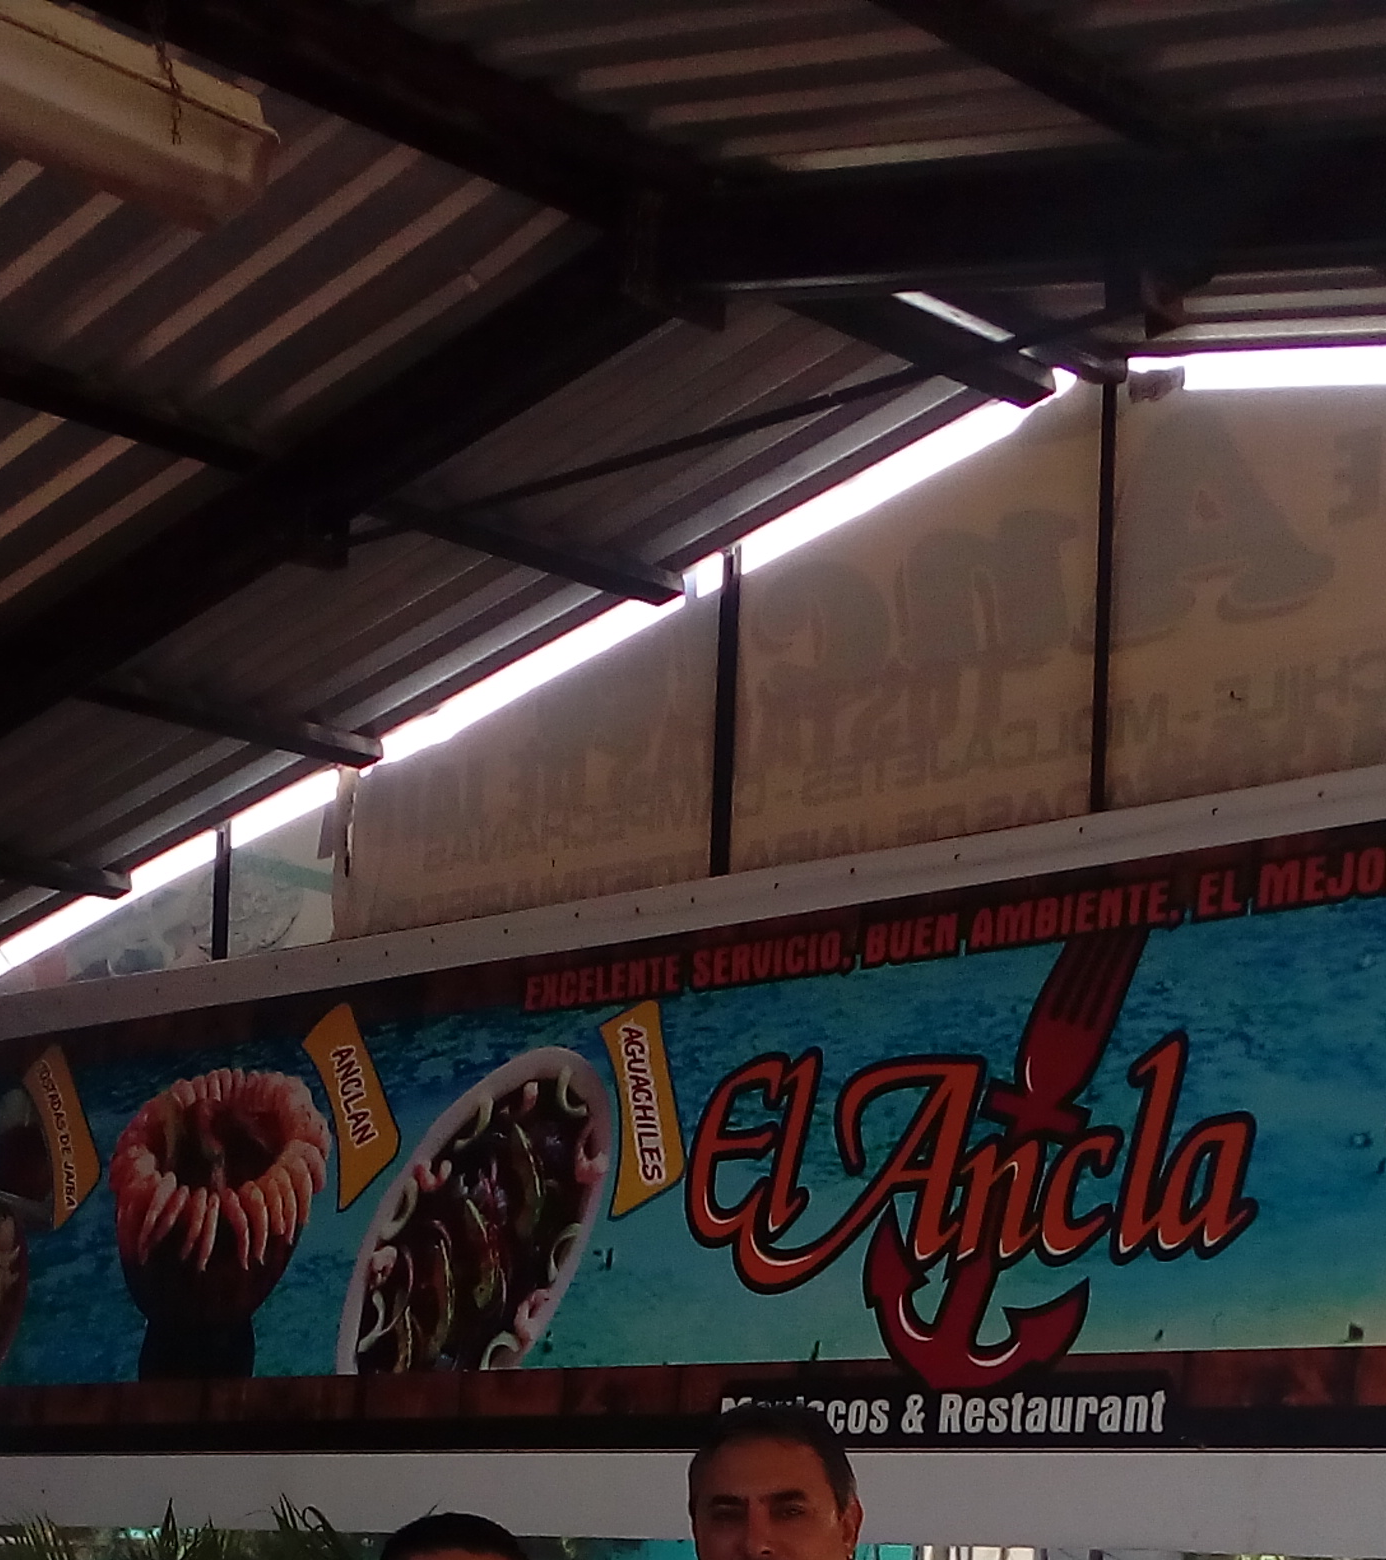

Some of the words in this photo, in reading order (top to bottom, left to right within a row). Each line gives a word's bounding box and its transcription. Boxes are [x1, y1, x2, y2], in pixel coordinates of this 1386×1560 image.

[523, 954, 680, 1012] EXCELENTE
[863, 912, 957, 963] BUEN
[1197, 871, 1243, 917] EL
[59, 1133, 73, 1155] DE
[331, 1045, 378, 1146] ANCLAN
[621, 1024, 663, 1183] AGUACHILES
[686, 1048, 823, 1247] El
[63, 1160, 78, 1210] JAIBA
[735, 1031, 1260, 1293] Ancla
[900, 1393, 926, 1434] &
[937, 1390, 1167, 1434] Restaurant
